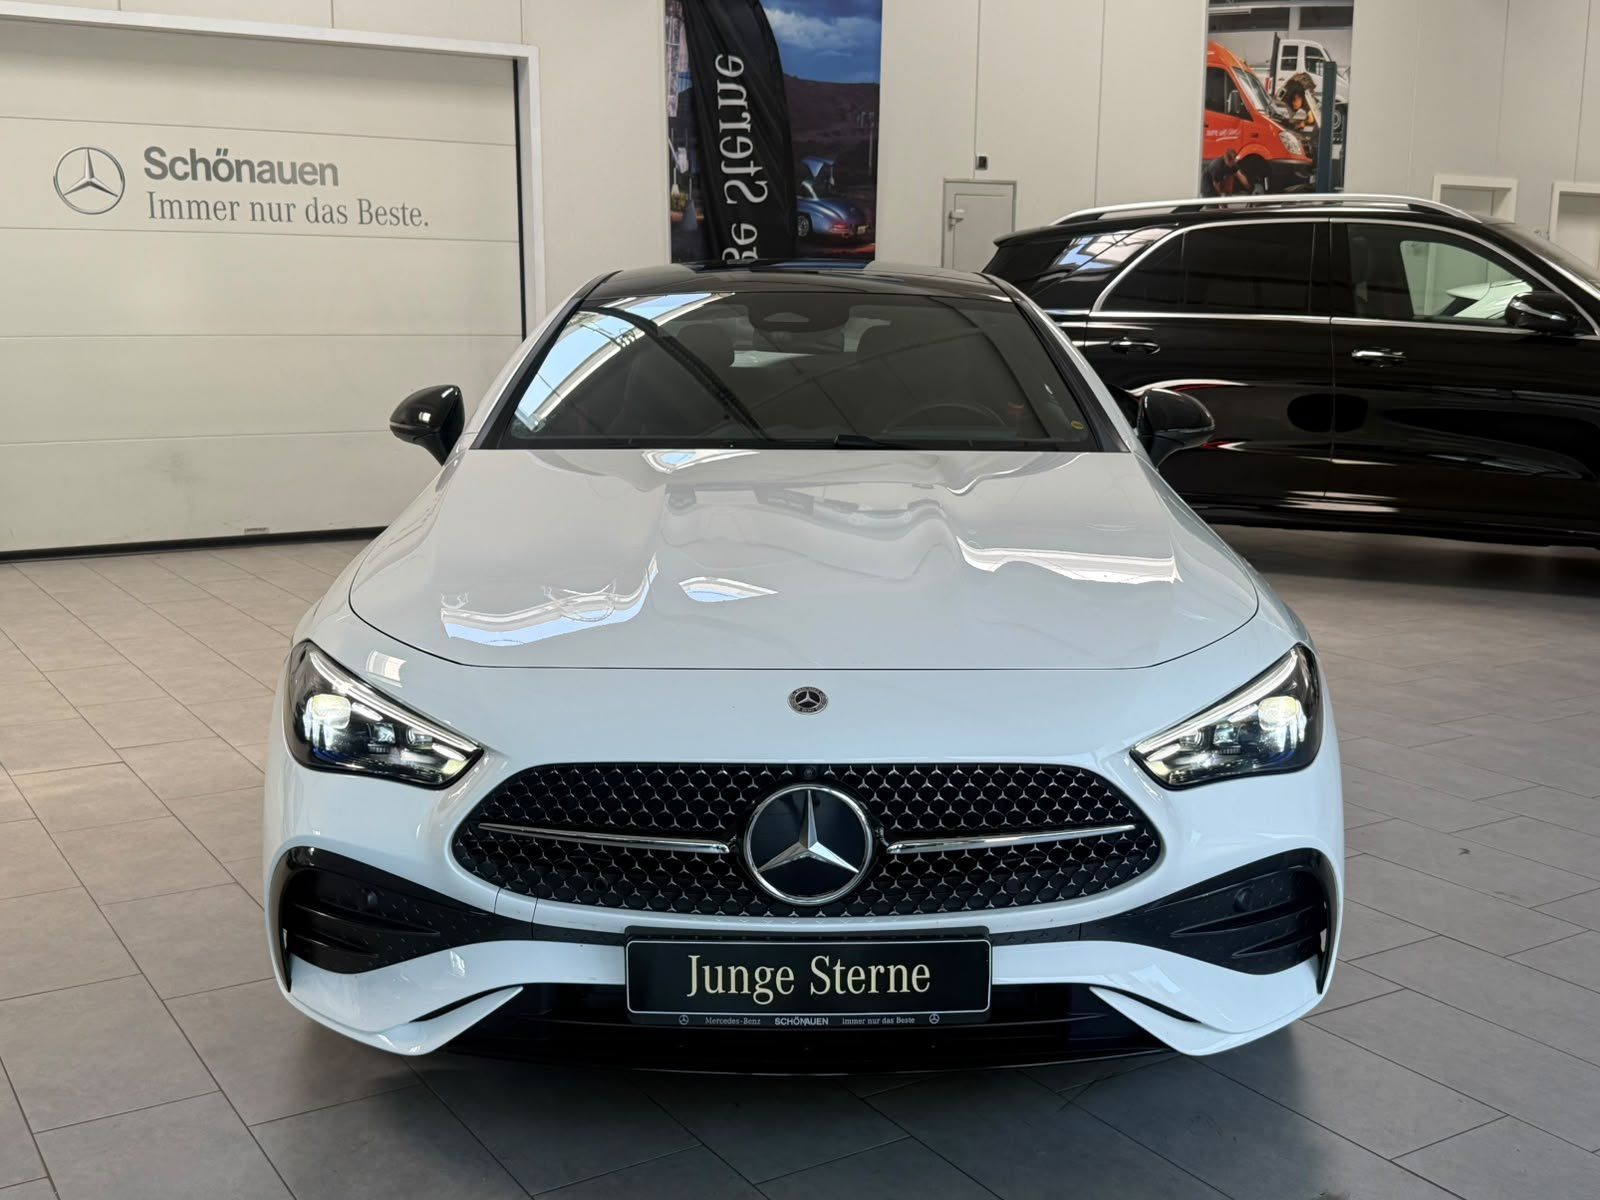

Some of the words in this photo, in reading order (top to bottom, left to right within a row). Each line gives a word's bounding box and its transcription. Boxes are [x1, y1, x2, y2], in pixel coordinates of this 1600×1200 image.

[146, 190, 240, 221] Immer
[249, 201, 296, 223] nur
[305, 197, 348, 224] das
[357, 198, 429, 228] Beste.
[686, 954, 795, 1005] Junge
[810, 954, 931, 996] Sterne
[705, 1016, 760, 1025] Mercedes-Benz
[774, 1016, 829, 1026] SCHÖNAUEN
[842, 1017, 865, 1025] Immer
[882, 1016, 894, 1024] das
